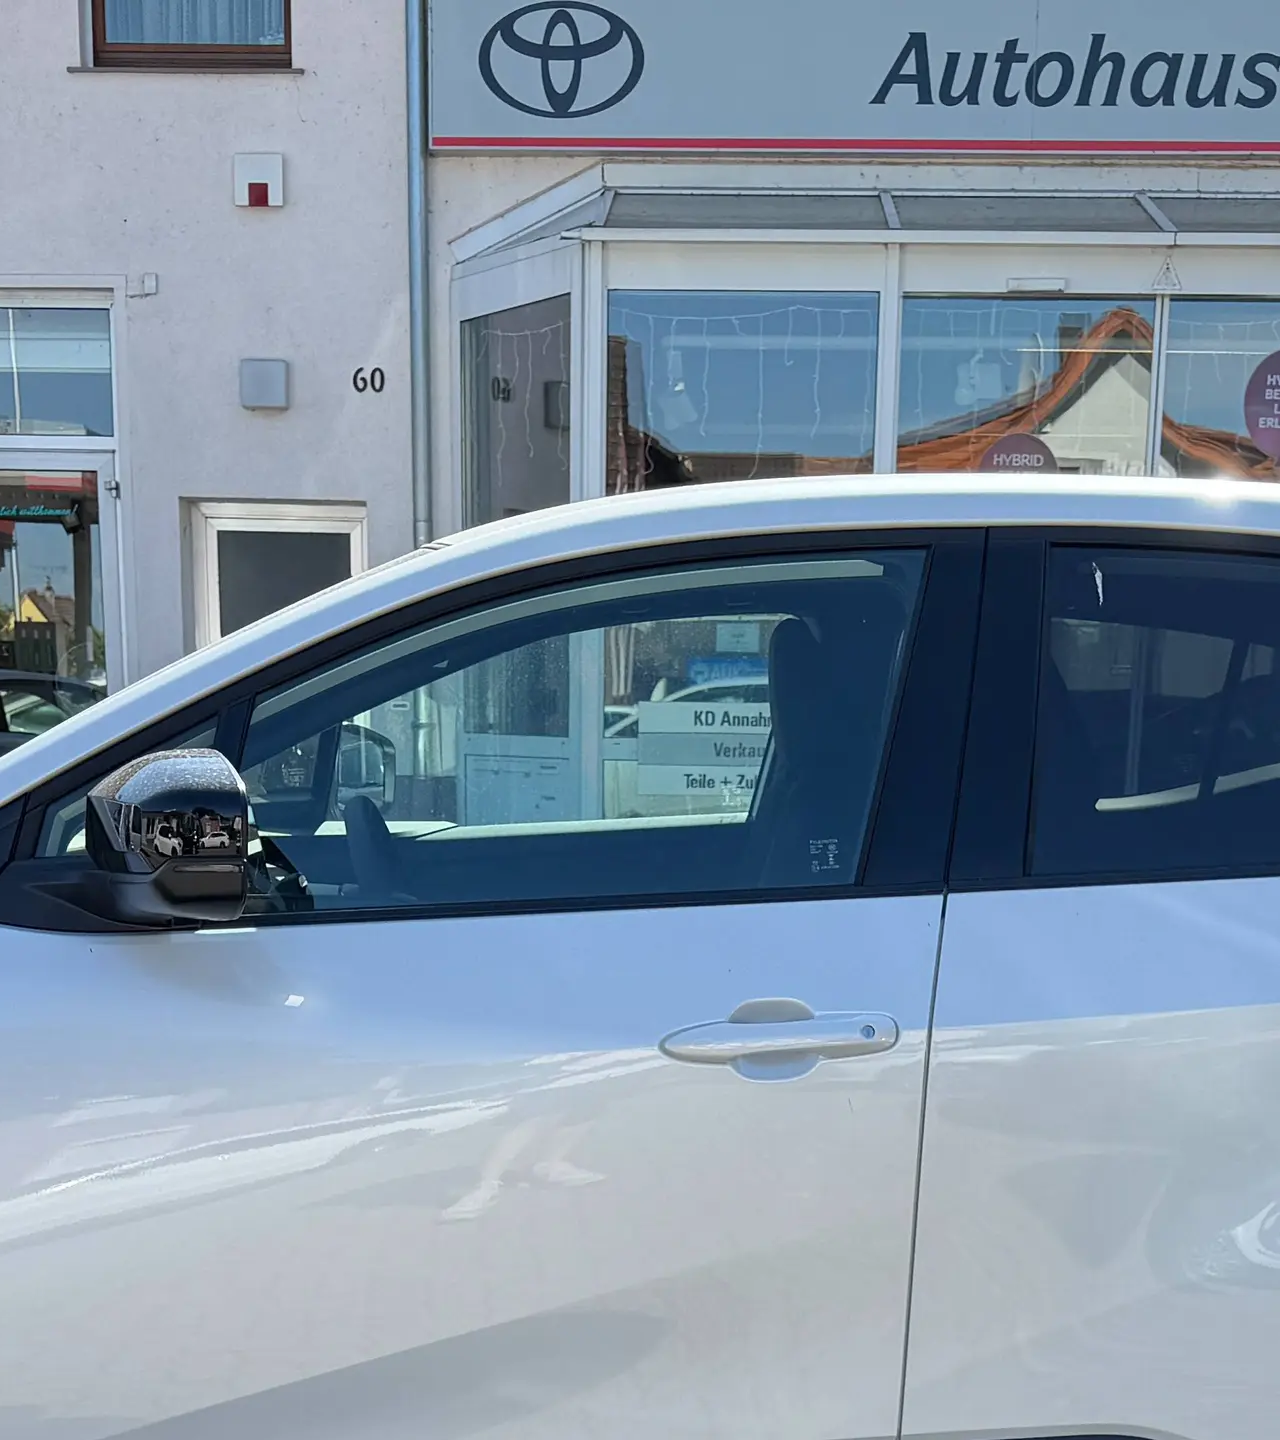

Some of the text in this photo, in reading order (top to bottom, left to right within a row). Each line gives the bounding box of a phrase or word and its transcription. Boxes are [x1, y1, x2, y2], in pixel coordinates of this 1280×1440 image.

[352, 367, 385, 393] 60
[993, 454, 1044, 466] HYBRID
[693, 710, 715, 726] KD
[713, 742, 765, 758] Verkau
[684, 774, 715, 789] Teile
